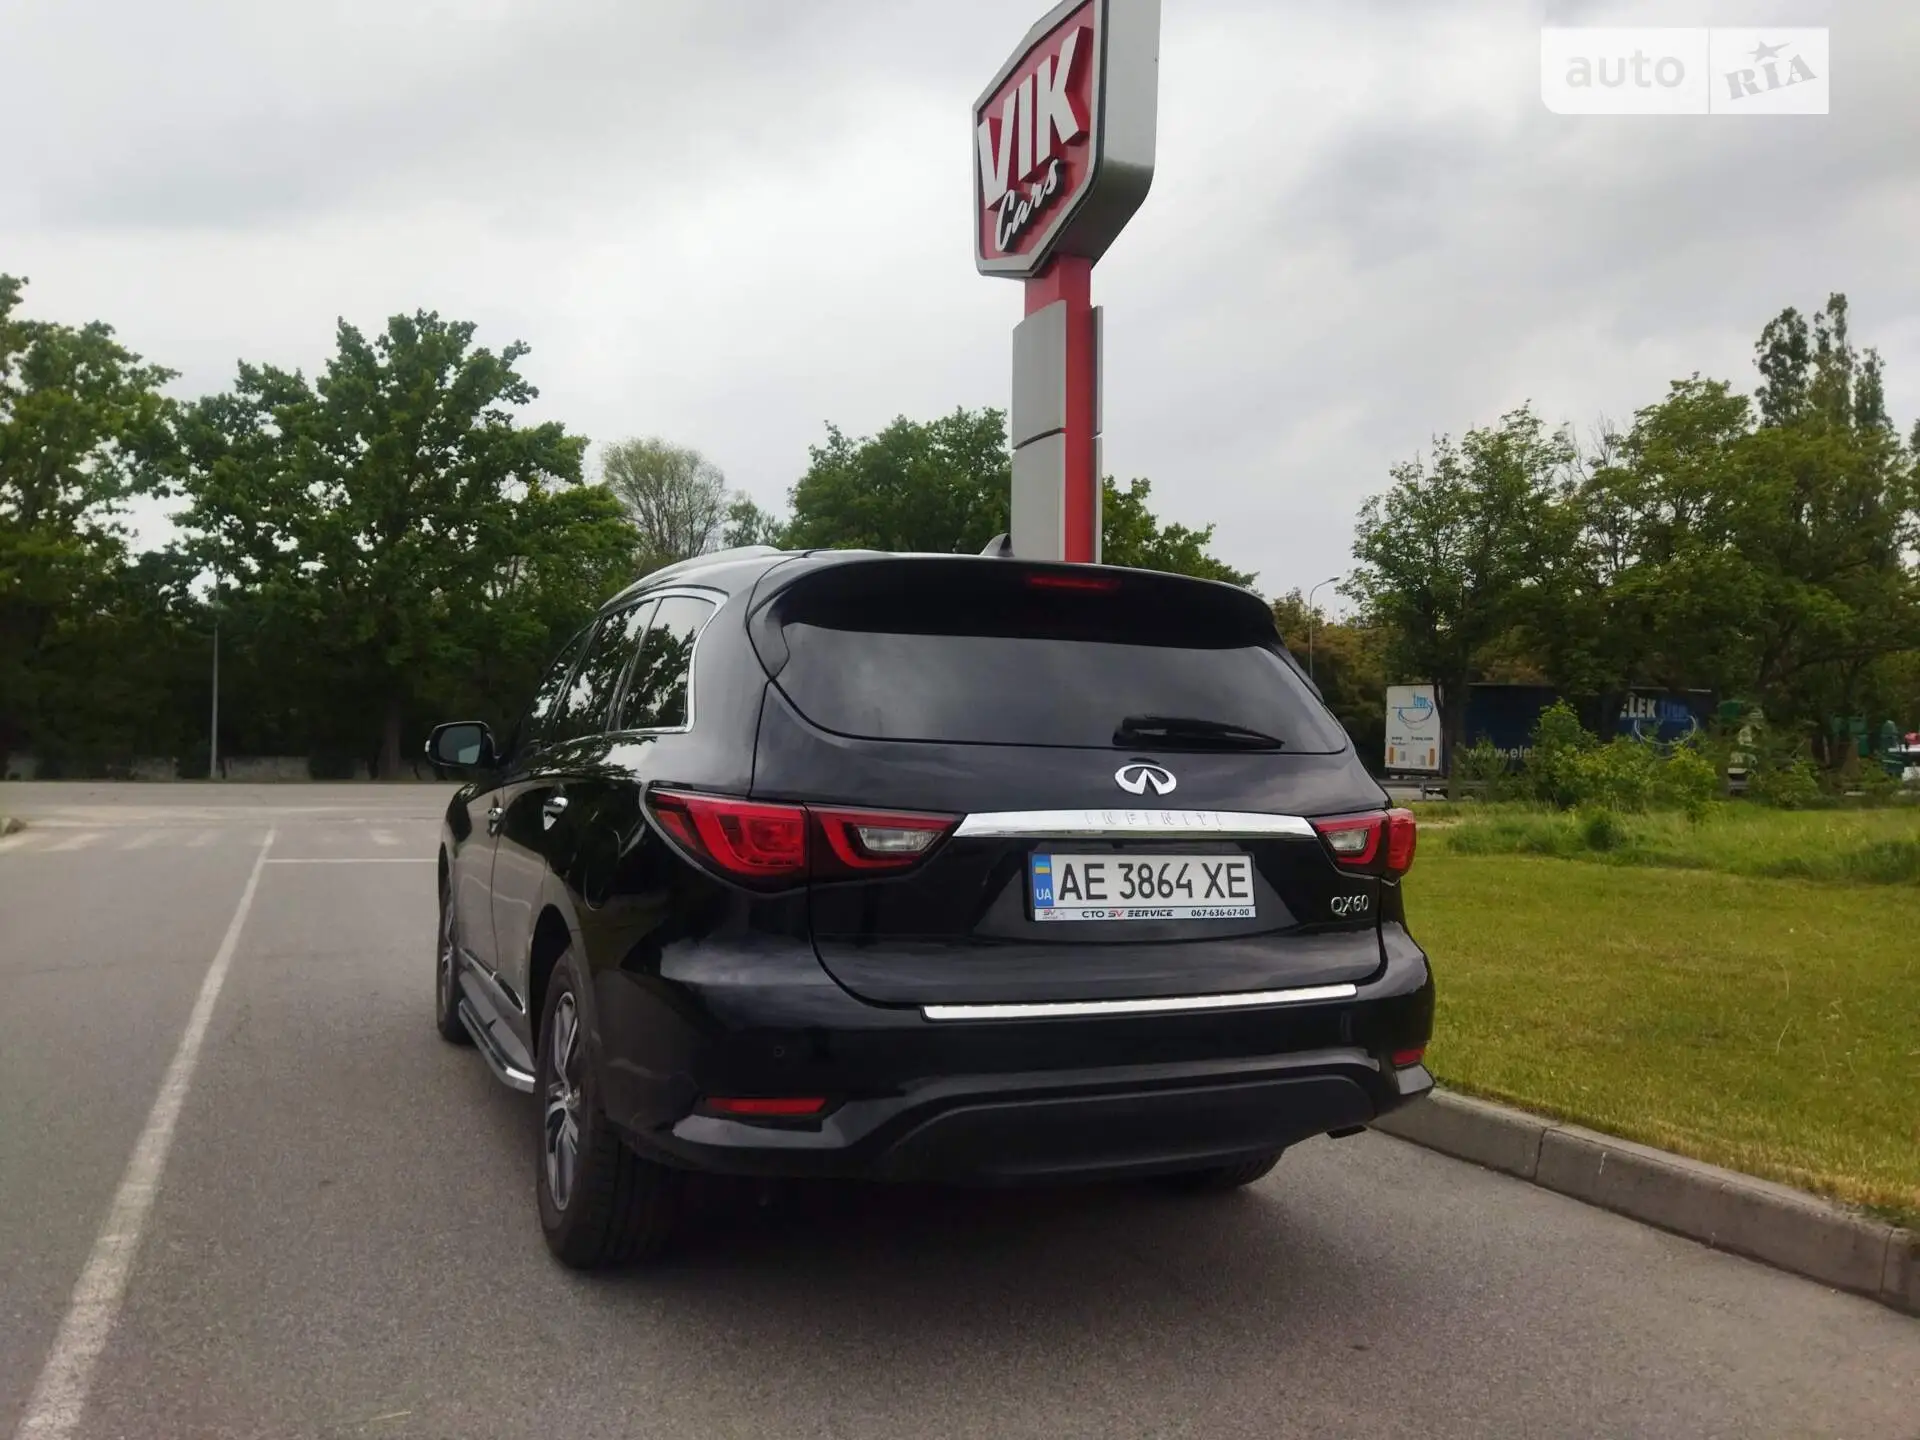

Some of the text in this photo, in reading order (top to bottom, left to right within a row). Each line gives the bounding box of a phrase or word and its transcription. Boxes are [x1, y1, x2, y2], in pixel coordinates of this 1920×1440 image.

[978, 26, 1080, 210] VIK
[995, 158, 1060, 252] Cars
[1084, 811, 1223, 826] INFINITI
[1058, 862, 1249, 901] AE 3864 XE
[1036, 888, 1052, 901] UA
[1108, 909, 1125, 917] SV
[1127, 908, 1174, 917] SERVICE
[1191, 908, 1250, 918] 067-636-67-00
[1331, 894, 1369, 917] QX60
